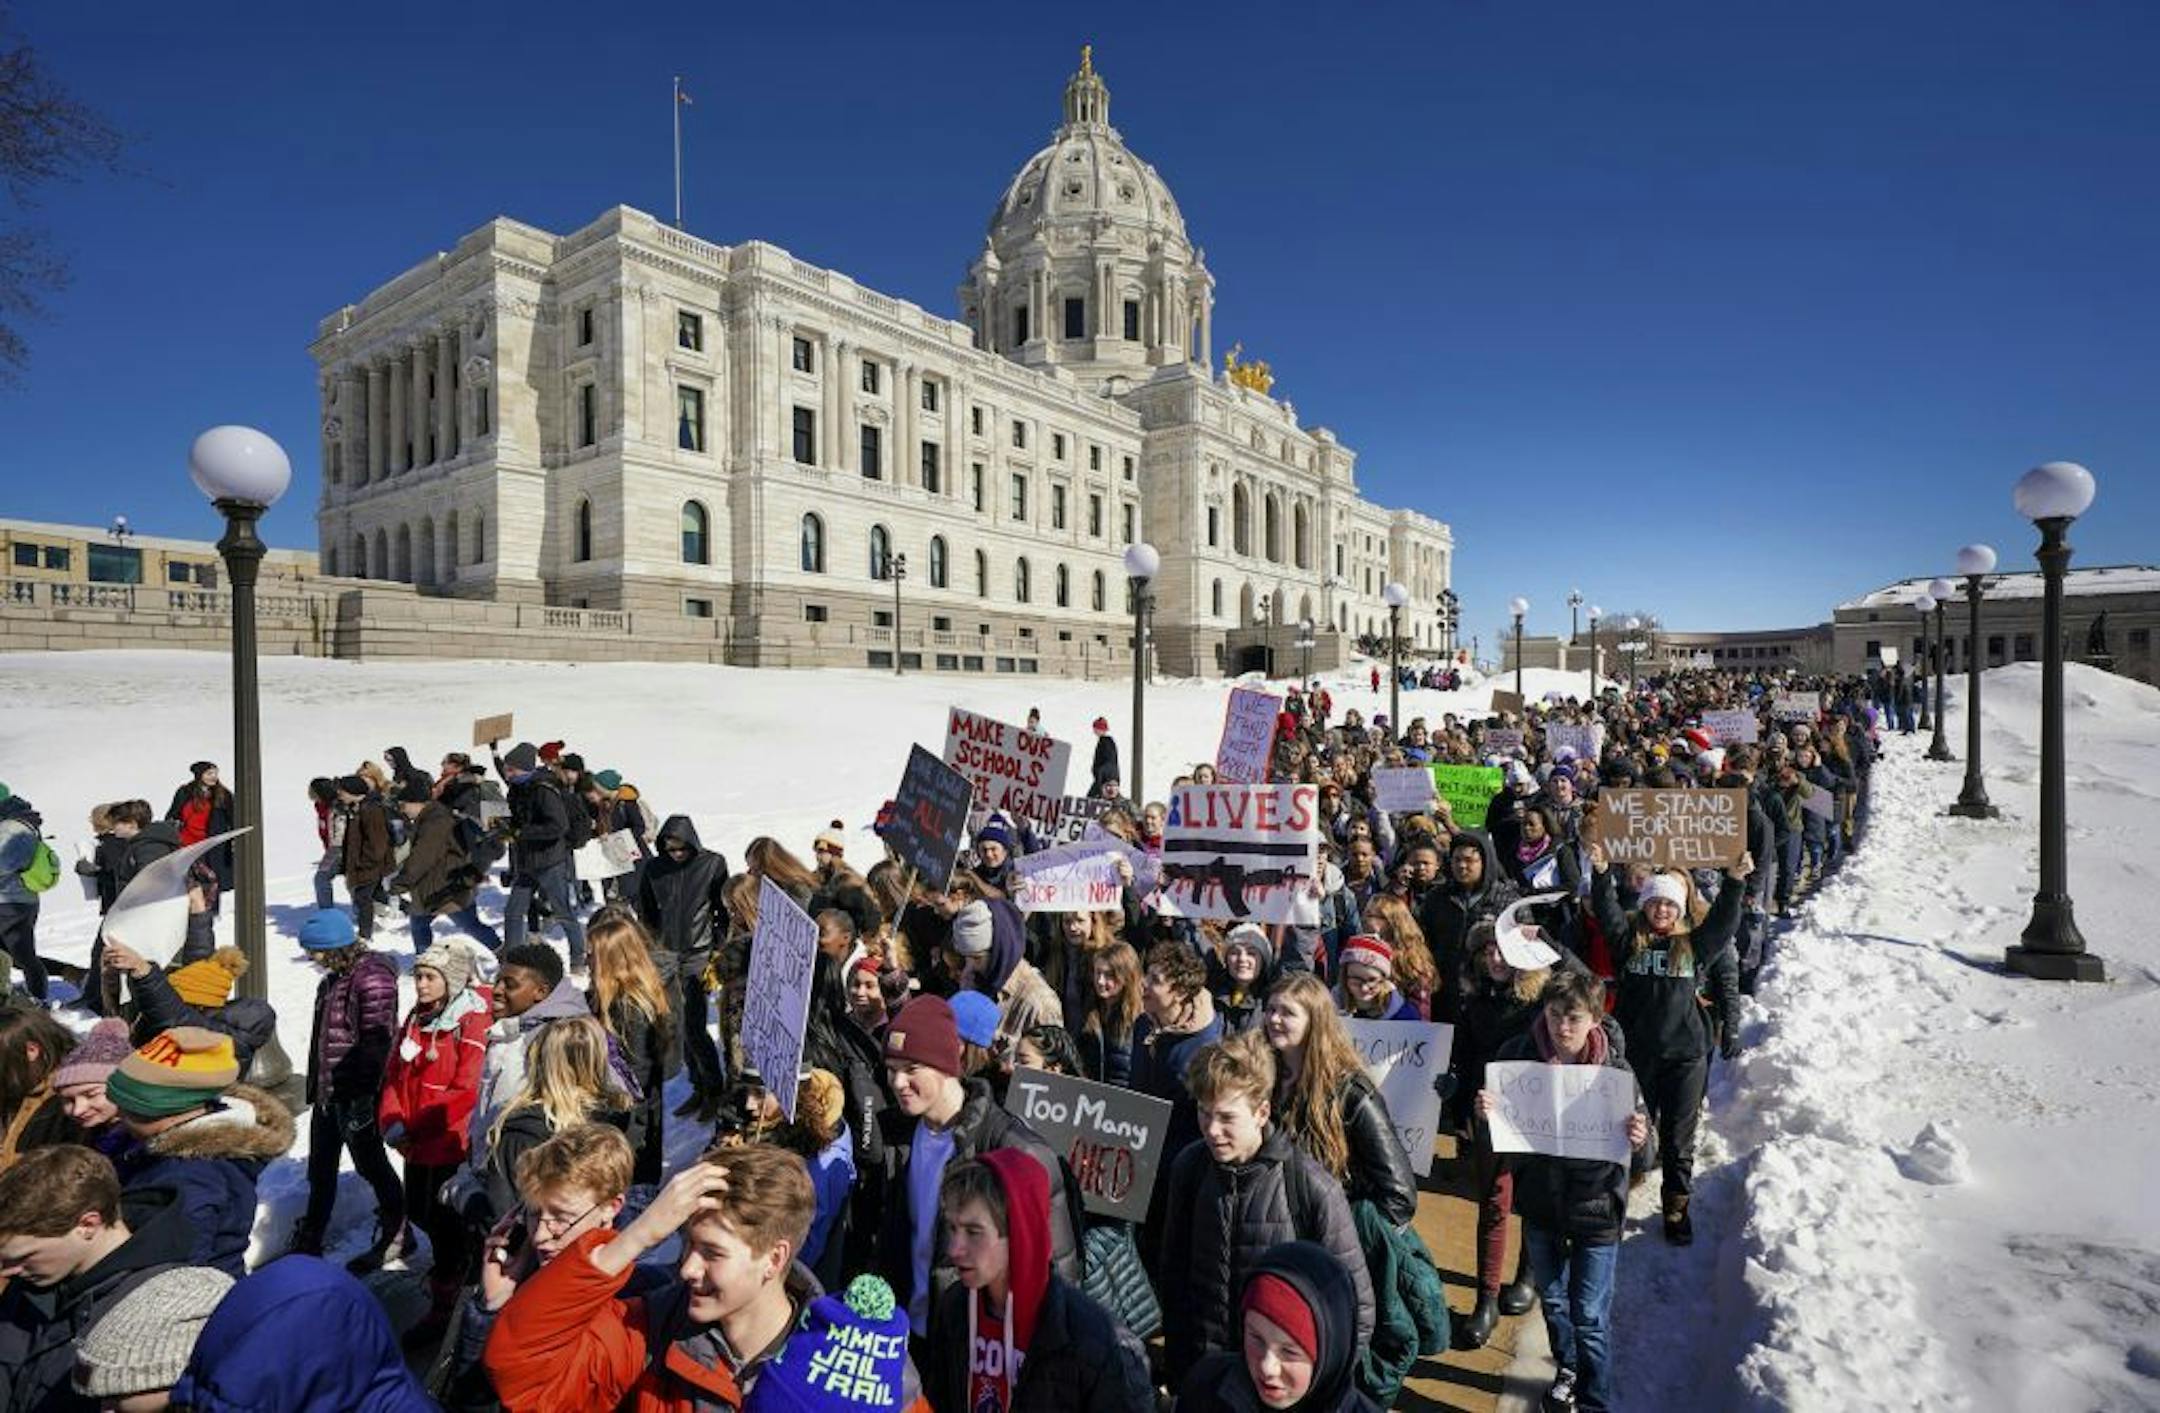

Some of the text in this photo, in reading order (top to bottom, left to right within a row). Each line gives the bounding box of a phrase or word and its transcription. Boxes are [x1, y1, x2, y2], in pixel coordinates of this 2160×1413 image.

[951, 711, 1054, 760] MAKE OUR
[955, 740, 1044, 787] SCHOOLS
[1000, 785, 1062, 827] AGAIN
[1183, 786, 1316, 832] LIVES
[1605, 792, 1734, 816] WE STAND
[1628, 815, 1739, 837] FOR THOSE
[1604, 836, 1729, 861] WHO FELL
[1089, 881, 1118, 905] NRA
[1020, 1082, 1149, 1150] Too Many
[826, 1323, 903, 1359] MMCC
[812, 1345, 881, 1381] JAIL
[807, 1361, 894, 1406] TRAIL
